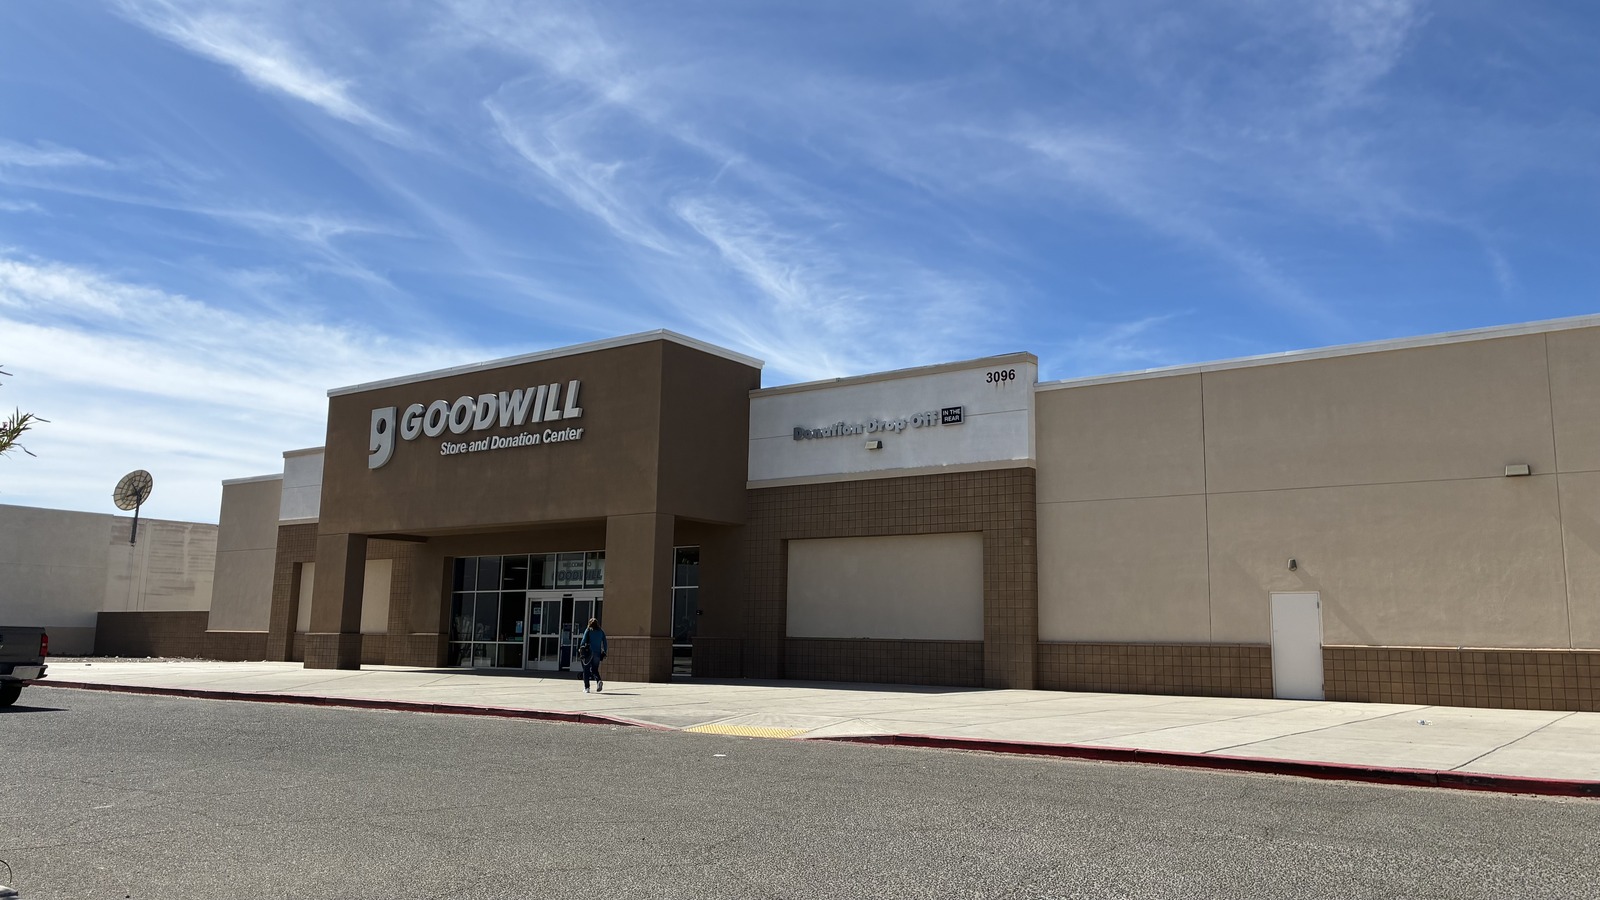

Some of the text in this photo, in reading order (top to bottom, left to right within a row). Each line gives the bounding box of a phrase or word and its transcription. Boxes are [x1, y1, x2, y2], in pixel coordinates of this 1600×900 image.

[986, 369, 1016, 383] 3096
[400, 380, 583, 440] GOODWILL
[793, 410, 938, 441] Donation Drop Off
[440, 427, 584, 456] Store and Donation Center
